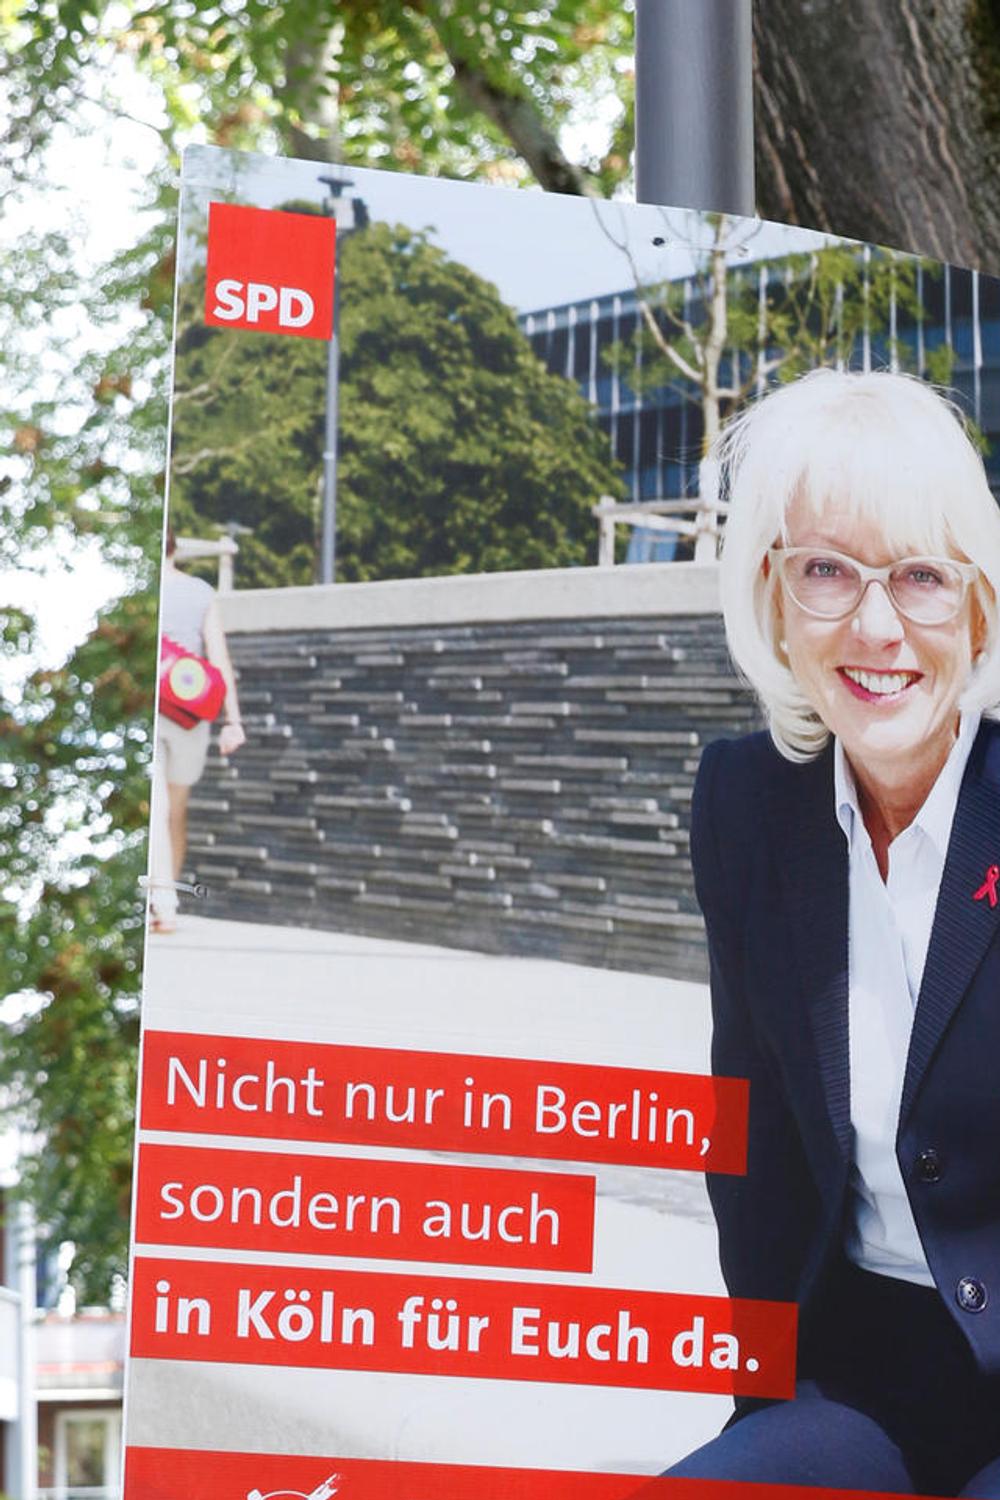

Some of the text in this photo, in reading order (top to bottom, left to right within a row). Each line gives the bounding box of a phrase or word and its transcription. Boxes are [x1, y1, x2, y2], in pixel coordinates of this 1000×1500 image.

[212, 278, 315, 329] SPD
[166, 1056, 711, 1156] Nicht nur in Berlin,
[159, 1175, 560, 1246] sondern auch
[154, 1279, 759, 1372] in Köln für Euch da.
